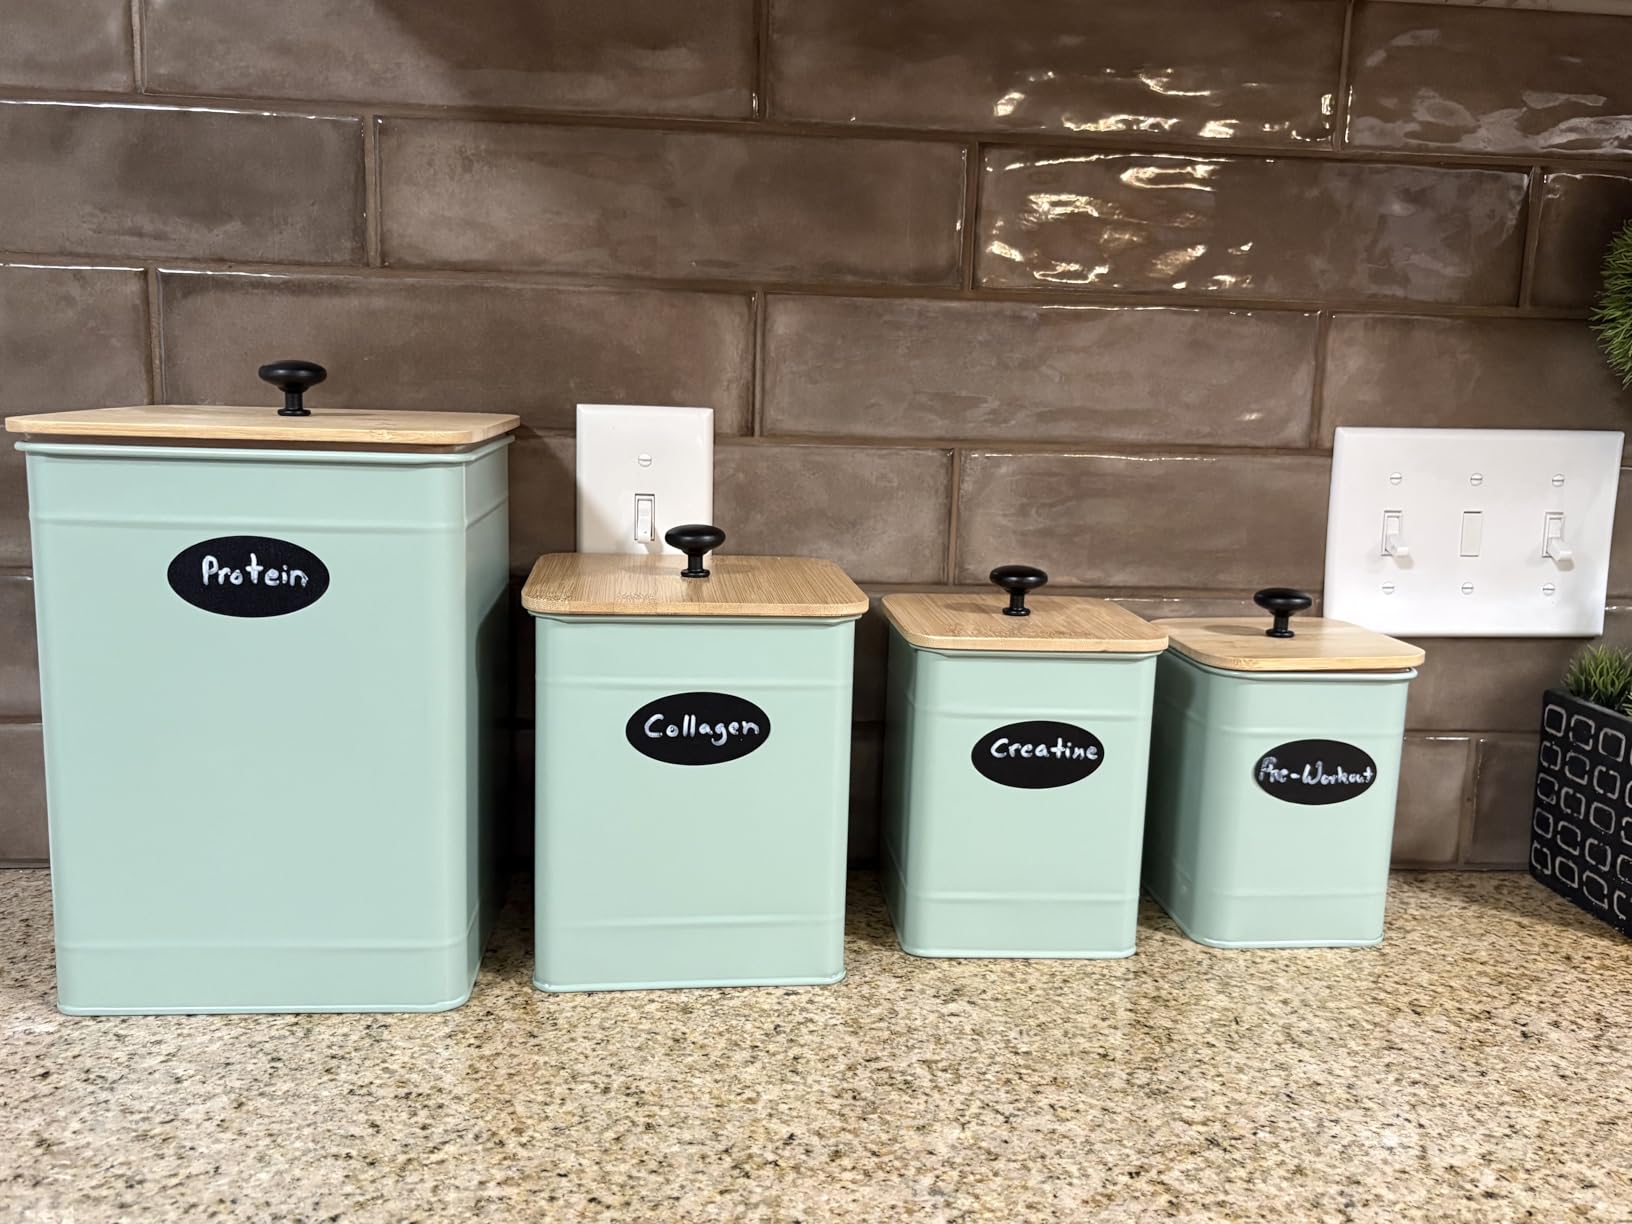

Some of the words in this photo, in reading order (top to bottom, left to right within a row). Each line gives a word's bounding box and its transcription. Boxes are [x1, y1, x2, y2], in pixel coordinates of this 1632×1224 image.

[202, 553, 309, 587] Protein
[644, 713, 760, 746] Collagen
[990, 737, 1098, 760] Creatine
[1259, 756, 1373, 785] Pre-Workout
